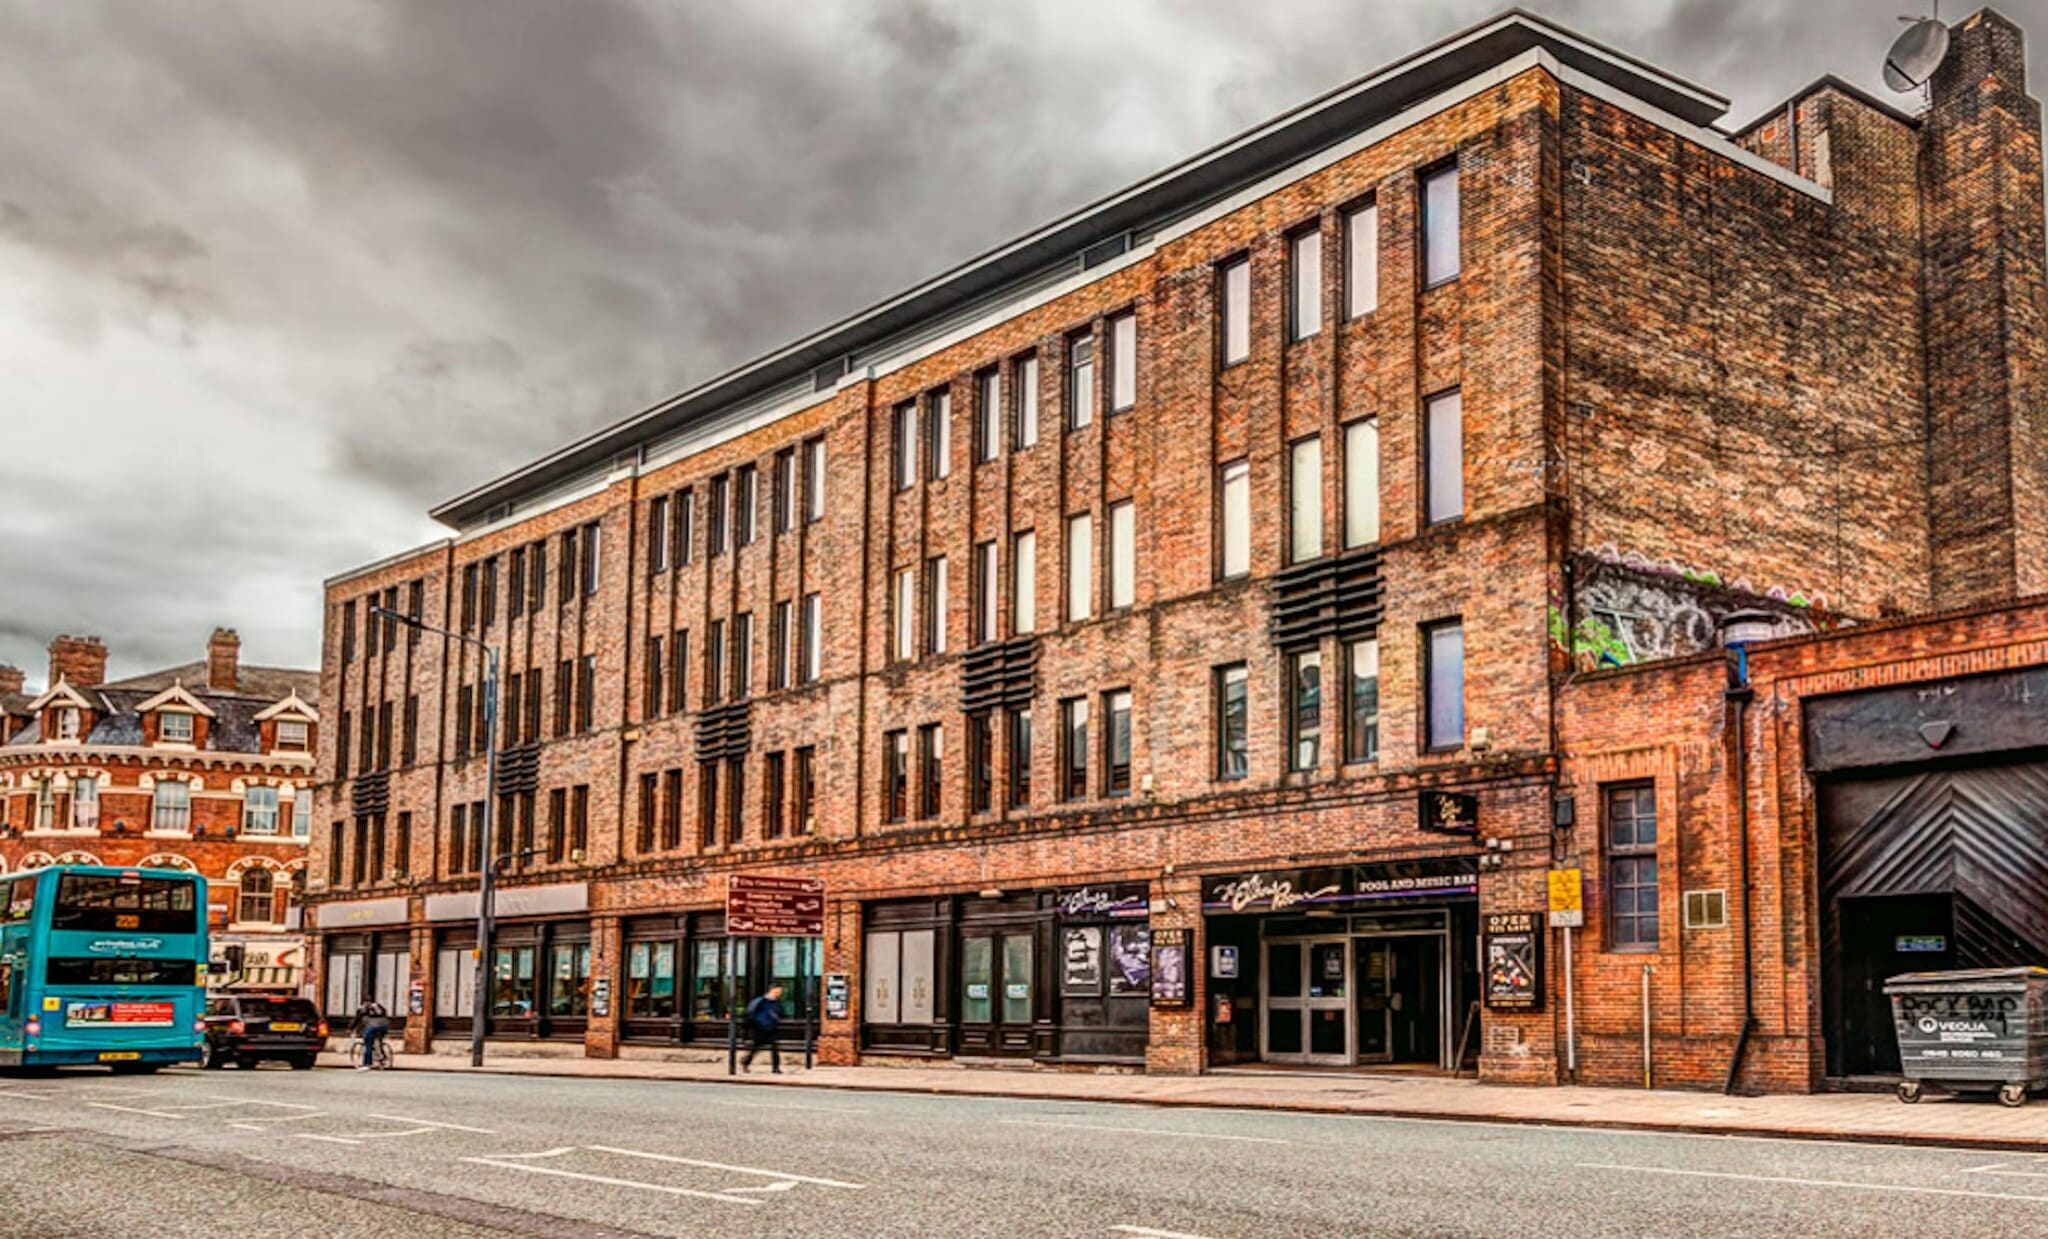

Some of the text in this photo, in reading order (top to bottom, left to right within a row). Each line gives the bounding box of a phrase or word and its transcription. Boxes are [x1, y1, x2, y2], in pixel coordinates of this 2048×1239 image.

[1391, 878, 1415, 891] AND
[1415, 876, 1452, 889] MUSIC
[1453, 874, 1477, 886] BAR
[1938, 1020, 1989, 1031] VEOLIA
